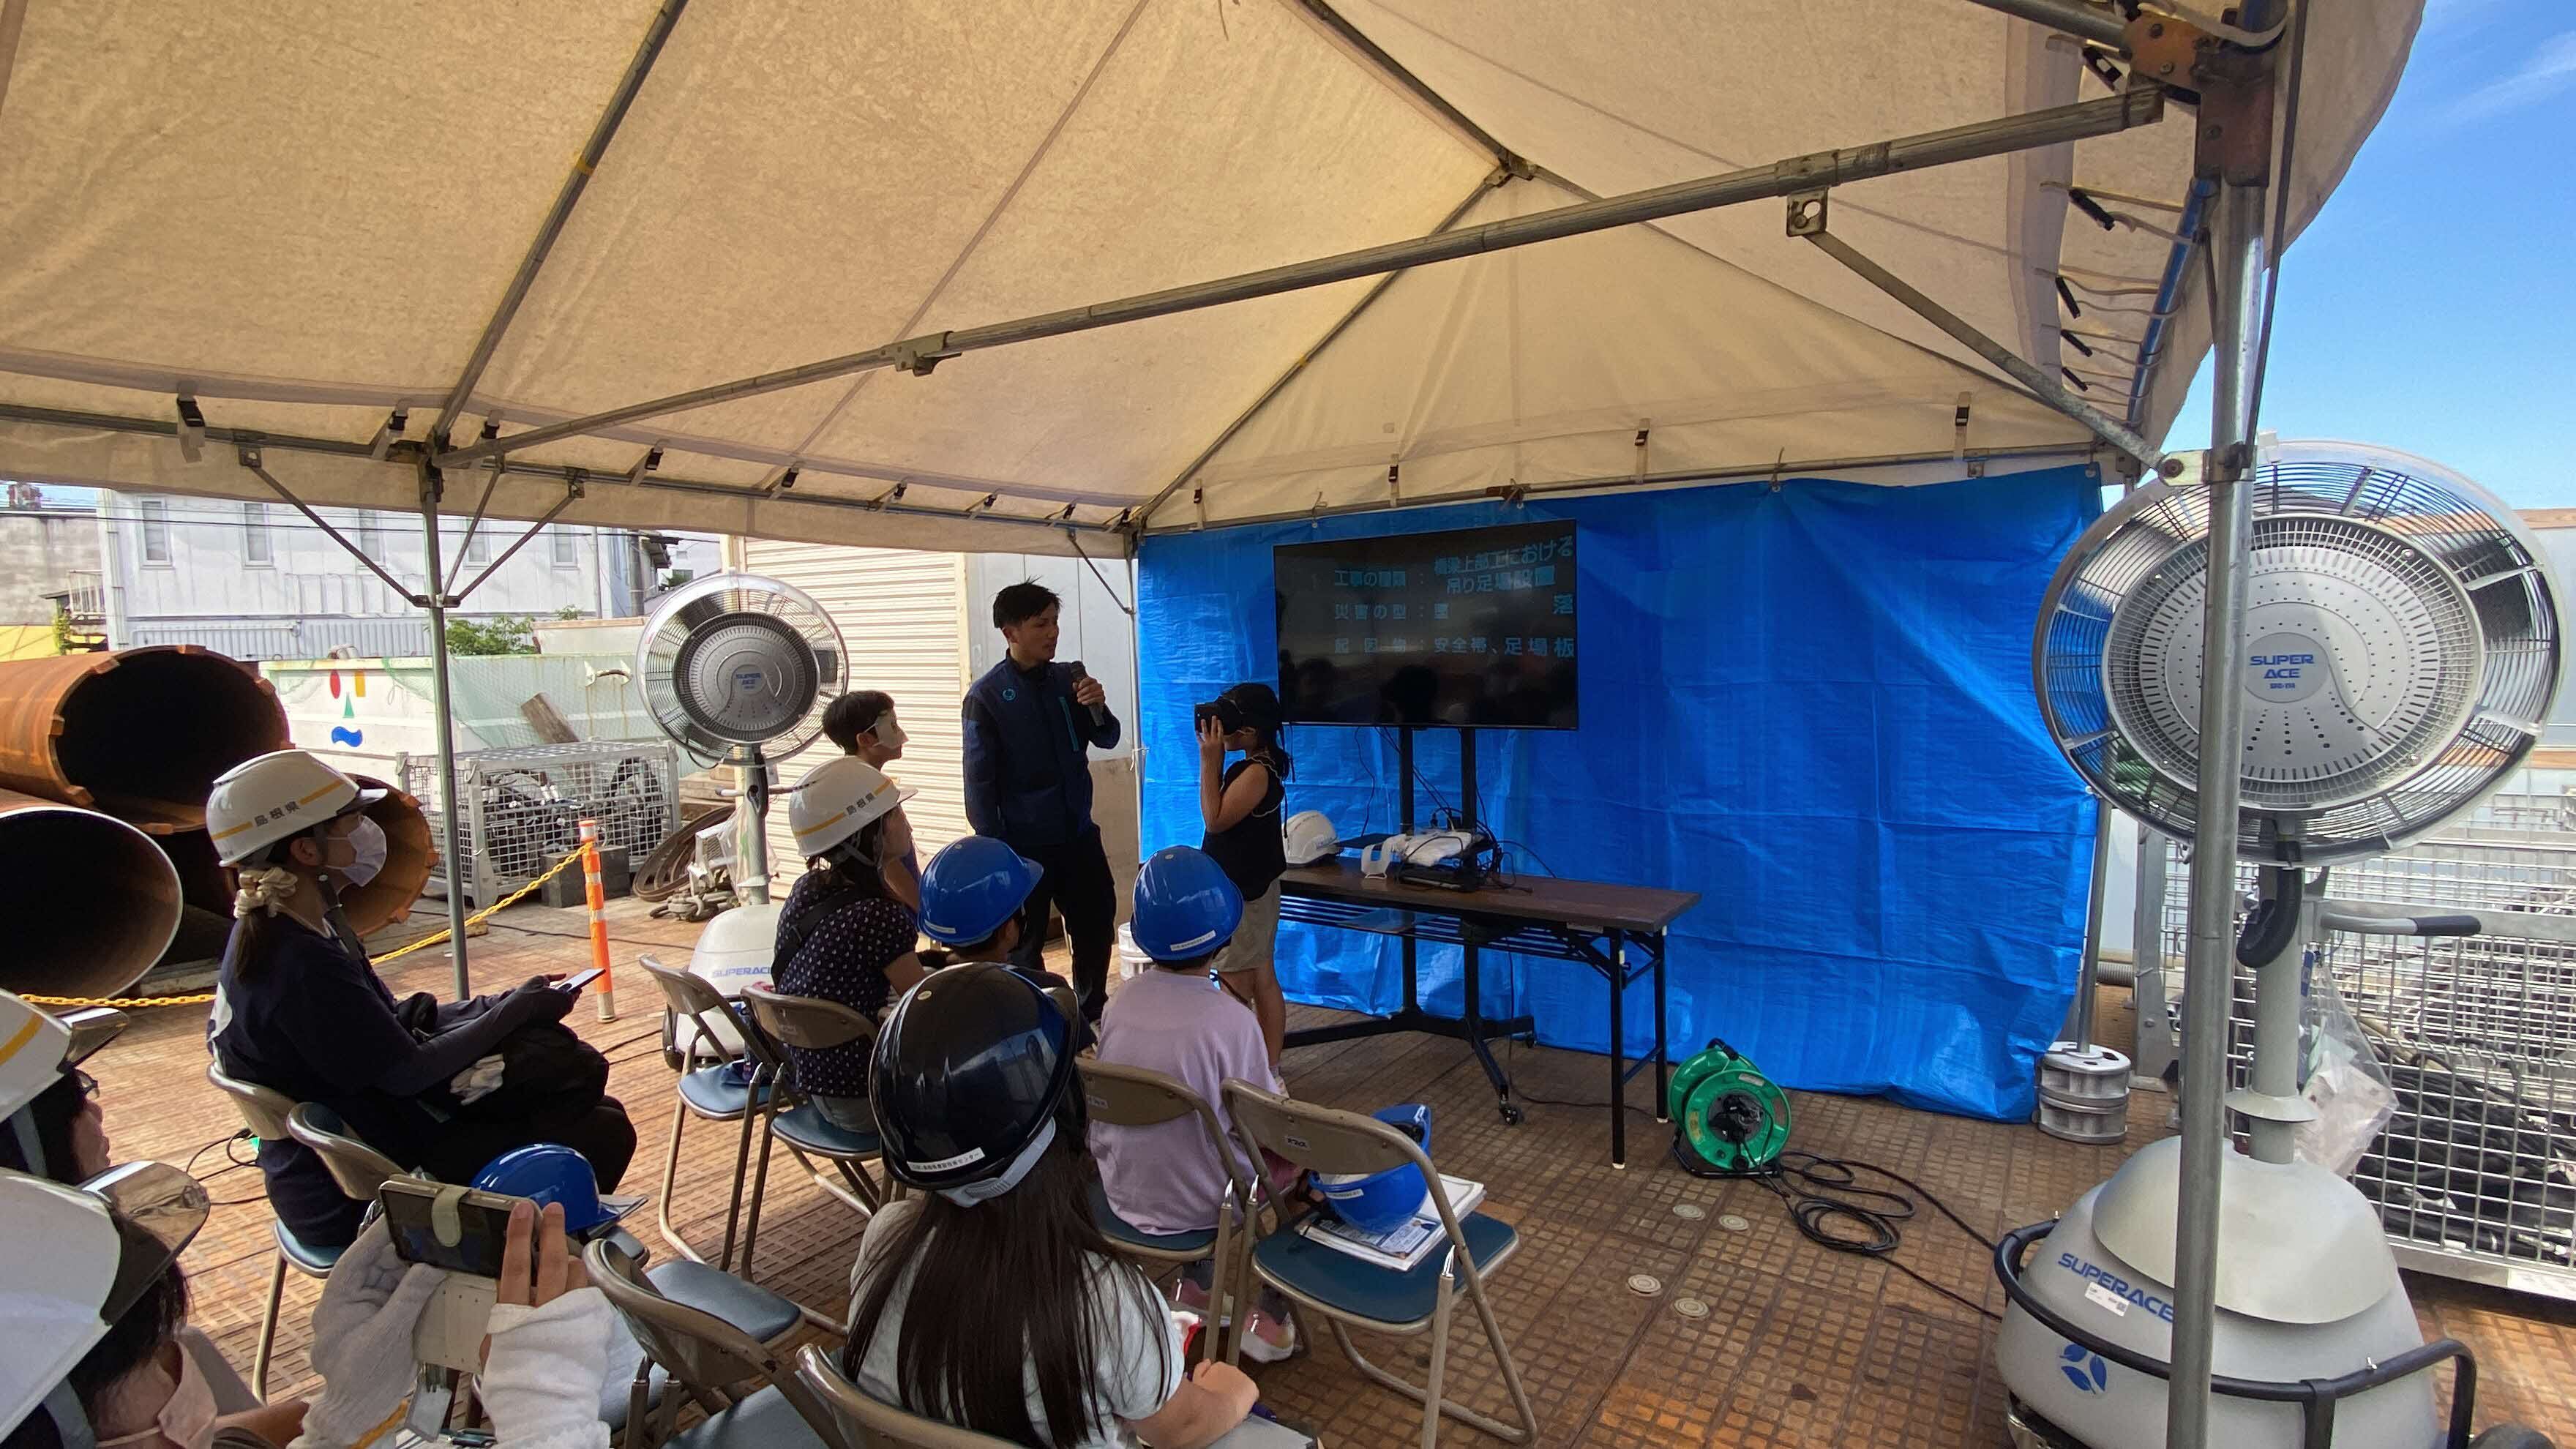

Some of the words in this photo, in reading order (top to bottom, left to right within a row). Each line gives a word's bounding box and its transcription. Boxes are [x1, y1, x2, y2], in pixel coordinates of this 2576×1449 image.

[2250, 654, 2314, 665] SUPER
[2264, 668, 2301, 679] ACE
[254, 801, 301, 826] 島根県
[2058, 1252, 2174, 1323] SUPERACE
